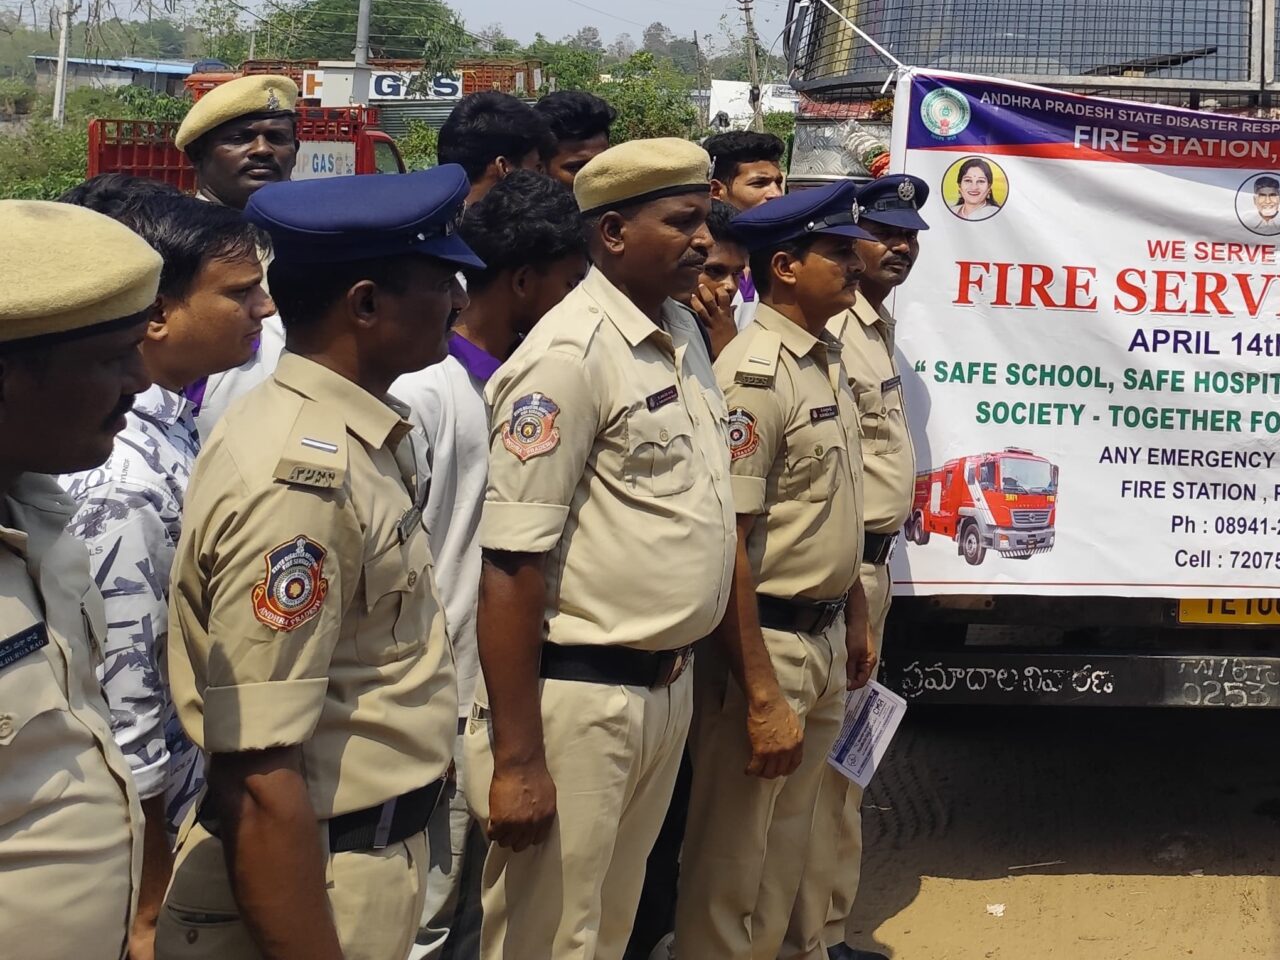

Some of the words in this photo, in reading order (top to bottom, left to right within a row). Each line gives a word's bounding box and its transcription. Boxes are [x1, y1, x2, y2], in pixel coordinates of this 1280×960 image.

[374, 74, 459, 97] GAS
[980, 90, 1041, 110] ANDHRA
[1045, 100, 1114, 120] PRADESH
[1118, 109, 1163, 125] STATE
[1166, 116, 1238, 132] DISASTER
[1073, 124, 1140, 152] FIRE
[1148, 133, 1279, 163] STATION,
[311, 152, 335, 174] GAS
[1147, 239, 1184, 260] WE
[1194, 241, 1275, 264] SERVE
[953, 261, 1098, 311] FIRE
[1127, 328, 1220, 355] APRIL
[933, 360, 997, 385] SAFE
[1005, 363, 1114, 394] SCHOOL,
[1123, 368, 1185, 392] SAFE
[976, 400, 1085, 426] SOCIETY
[1108, 405, 1242, 432] TOGETHER
[1099, 446, 1142, 465] ANY
[1148, 447, 1276, 469] EMERGENCY
[1121, 480, 1166, 499] FIRE
[1172, 481, 1257, 501] STATION
[1171, 515, 1196, 533] Ph
[1175, 549, 1211, 568] Cell
